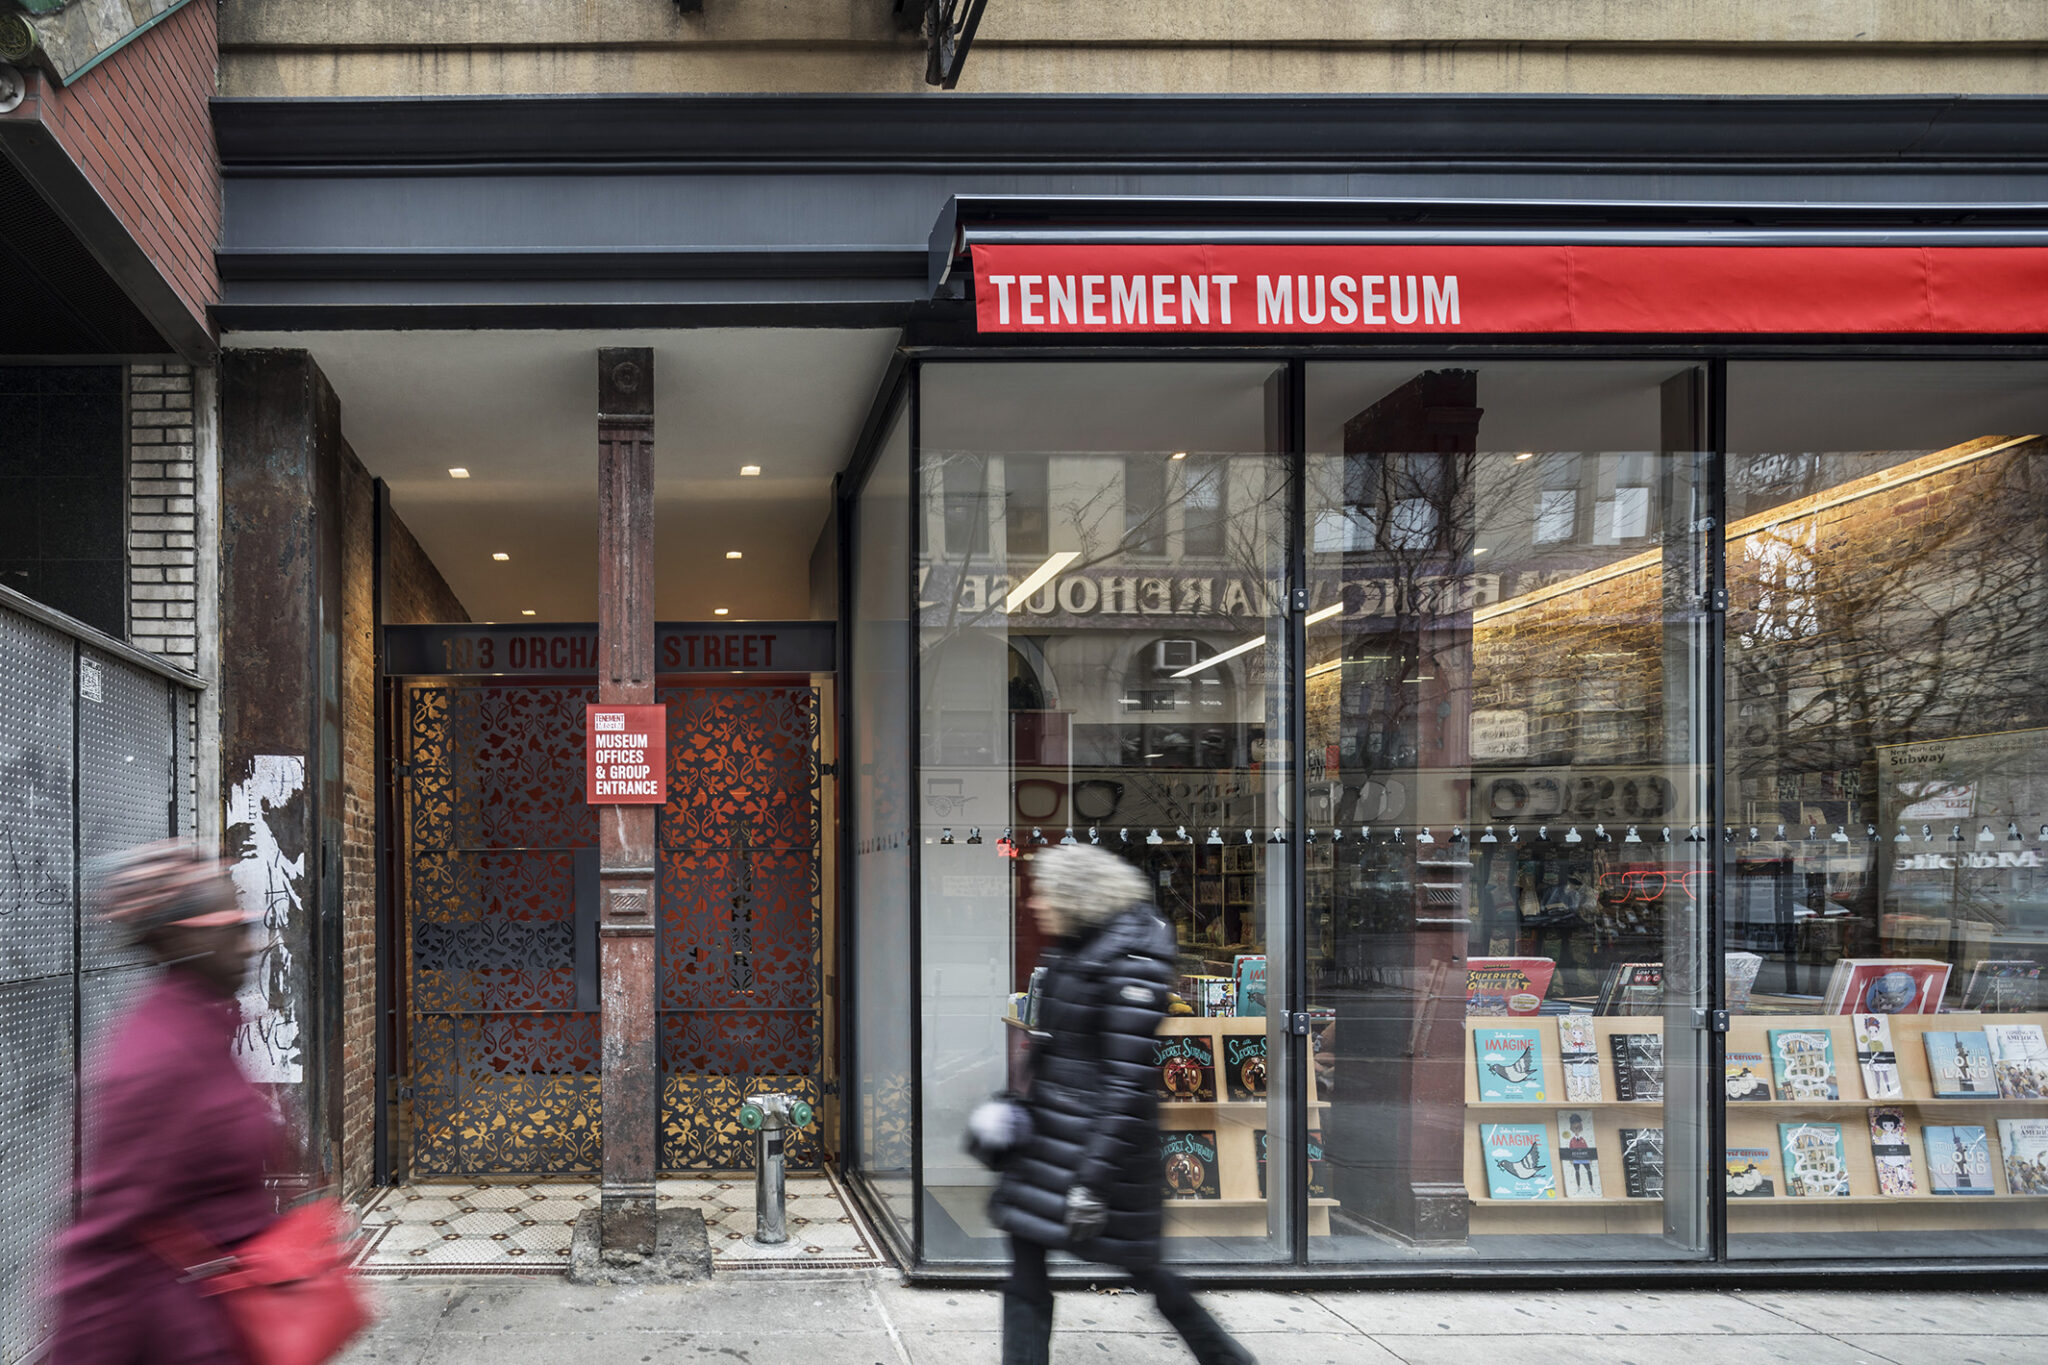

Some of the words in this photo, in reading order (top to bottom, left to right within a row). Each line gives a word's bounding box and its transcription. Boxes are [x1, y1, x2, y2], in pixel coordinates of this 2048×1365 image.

[988, 274, 1238, 326] TENEMENT
[1256, 274, 1461, 326] MUSEUM
[442, 637, 495, 670] 103
[508, 636, 599, 669] ORCHA
[662, 635, 777, 667] STREET
[595, 714, 624, 722] TENEMENT
[595, 734, 648, 748] MUSEUM
[595, 750, 644, 764] OFFICES
[1890, 752, 1946, 767] Subway
[595, 765, 606, 779] &
[610, 765, 650, 779] GROUP
[595, 781, 658, 795] ENTRANCE
[1466, 981, 1501, 991] OMIC
[1485, 1039, 1535, 1051] IMAGINE
[1614, 1036, 1630, 1098] TENEMENT
[1953, 1056, 1988, 1067] OUR
[1942, 1068, 1989, 1080] LAND
[1491, 1134, 1542, 1146] IMAGINE
[1951, 1151, 1986, 1162] OUR
[1940, 1163, 1987, 1175] LAND
